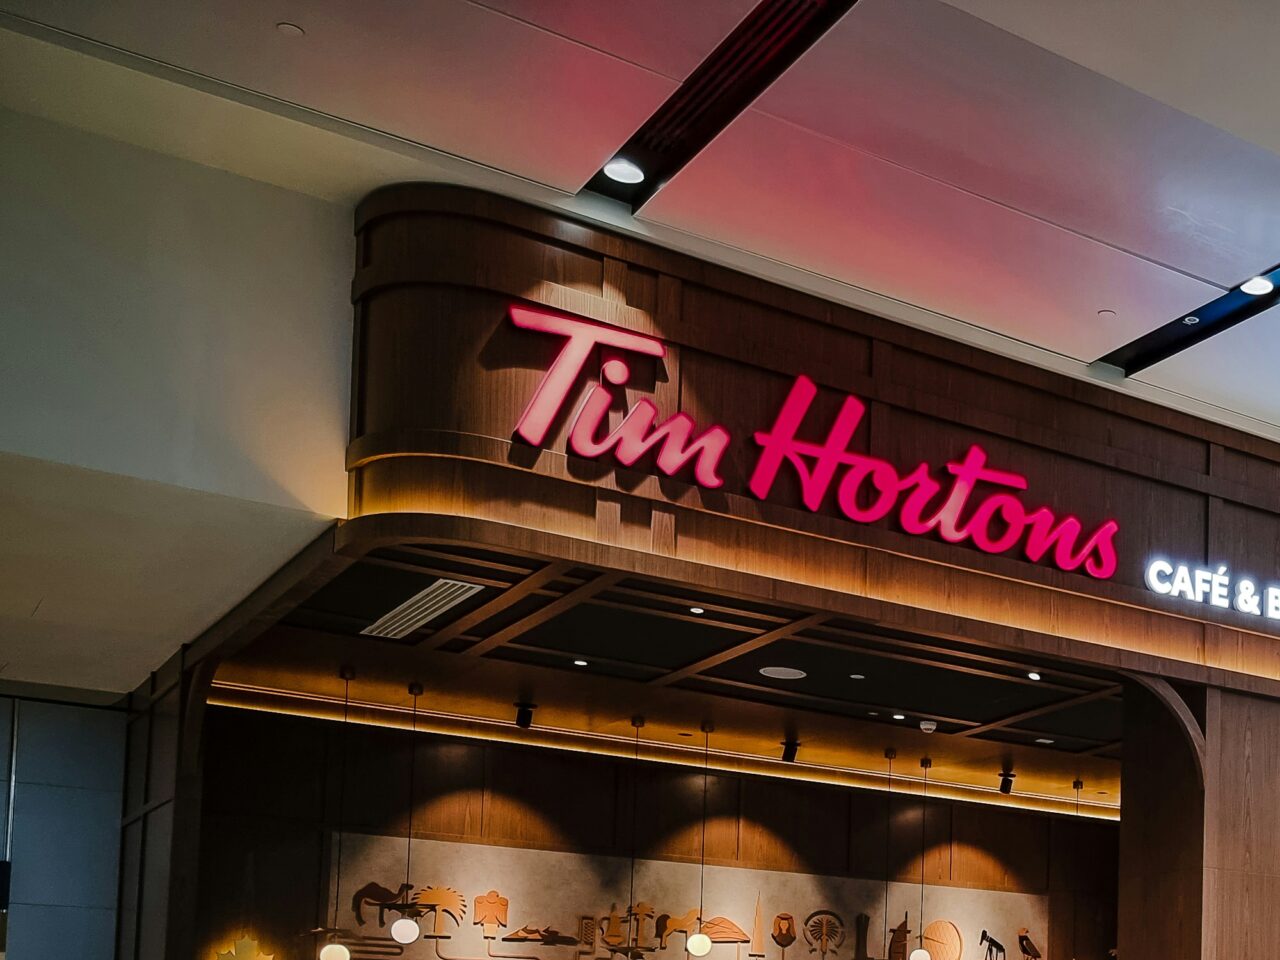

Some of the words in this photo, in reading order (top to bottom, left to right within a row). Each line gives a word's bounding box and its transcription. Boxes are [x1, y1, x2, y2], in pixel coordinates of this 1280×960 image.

[510, 306, 730, 488] Tim
[749, 375, 1119, 579] Hortons
[1147, 560, 1229, 608] CAFÉ
[1235, 580, 1261, 616] &
